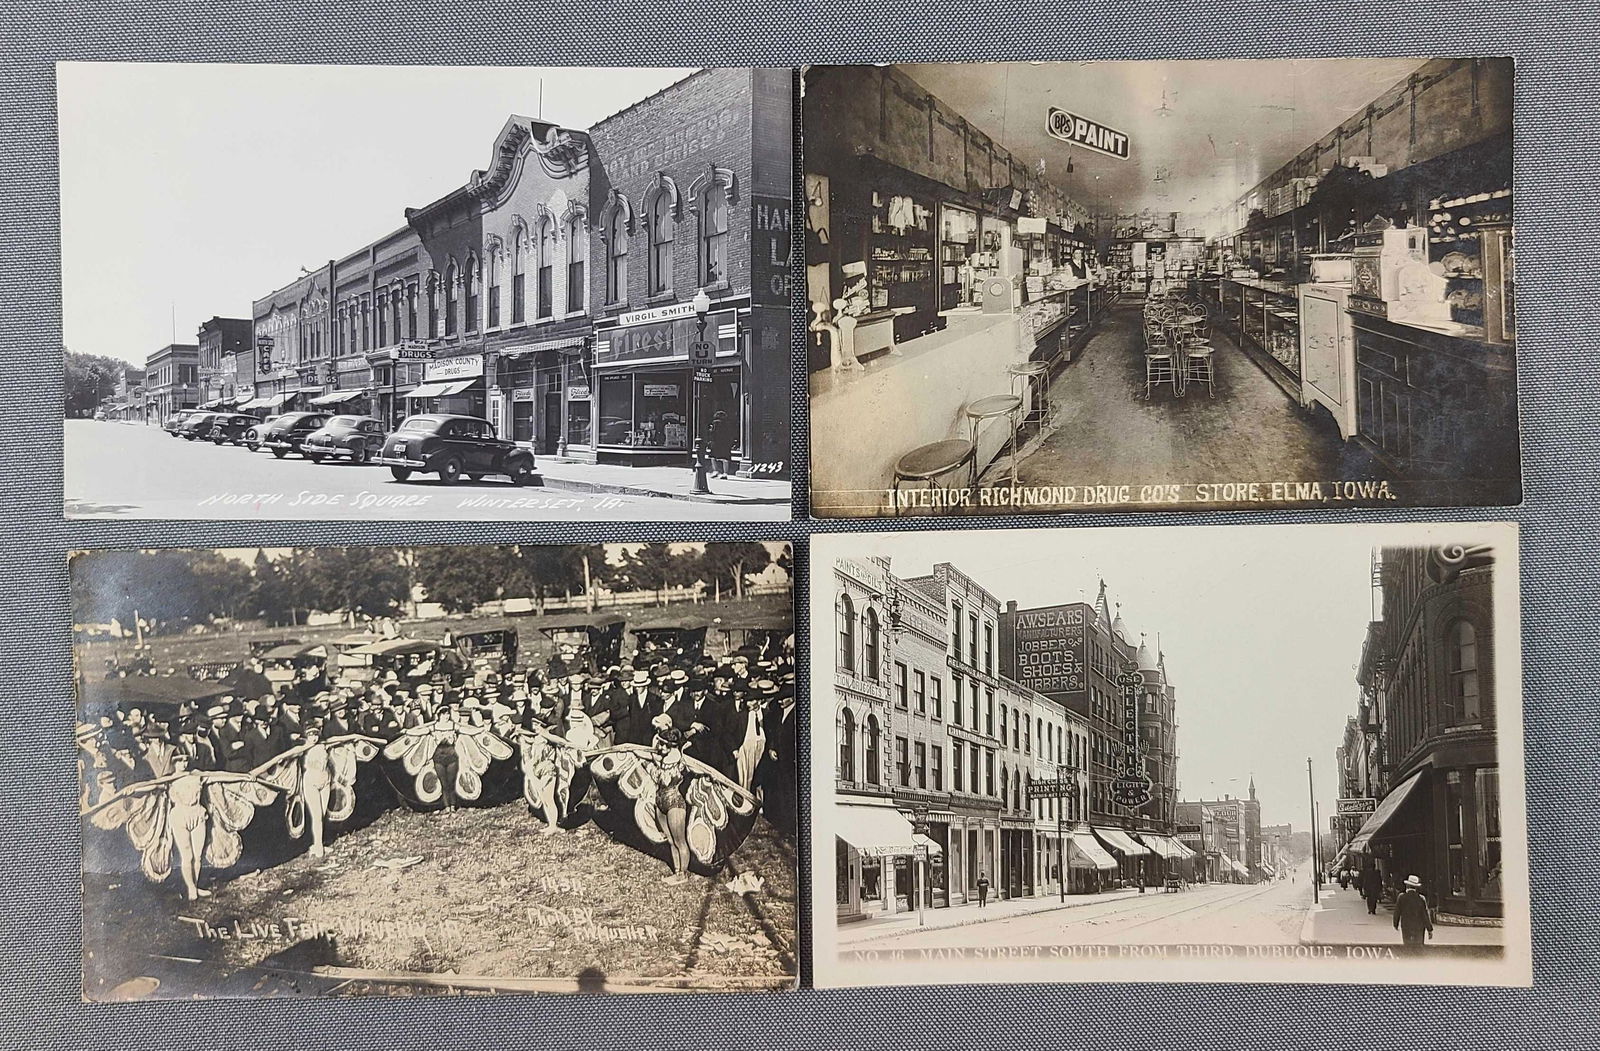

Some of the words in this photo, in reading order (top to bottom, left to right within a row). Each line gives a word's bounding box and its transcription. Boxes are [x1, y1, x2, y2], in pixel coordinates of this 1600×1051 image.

[1054, 115, 1070, 134] BPS
[1074, 118, 1126, 155] PAINT
[625, 312, 657, 324] VIRGIL
[661, 304, 695, 317] SMITH
[401, 351, 433, 359] DRUGS
[695, 350, 709, 358] U
[428, 359, 453, 371] MADISON
[455, 357, 480, 366] COUNTY
[444, 367, 461, 376] DRUGS
[198, 492, 284, 506] NORTH
[288, 491, 345, 507] SIDE
[349, 491, 431, 510] SQUARE
[456, 494, 585, 512] WINTERSET,
[886, 487, 972, 508] INTERIOR
[979, 486, 1076, 507] RICHMOND
[1082, 485, 1130, 505] DRUG
[1271, 482, 1328, 503] ELMA,
[1332, 480, 1397, 501] IOWA.
[1018, 639, 1067, 653] JOBBER
[1022, 662, 1073, 678] SHOES
[1073, 662, 1084, 674] &
[1125, 686, 1135, 777] ELECTRIC
[1027, 784, 1073, 793] PRINTNG
[1116, 795, 1148, 804] POWER
[920, 949, 966, 961] MAIN
[973, 946, 1042, 960] STREET
[1049, 946, 1109, 959] SOUTH
[1119, 945, 1168, 959] FROM
[1346, 946, 1401, 961] IOWA.
